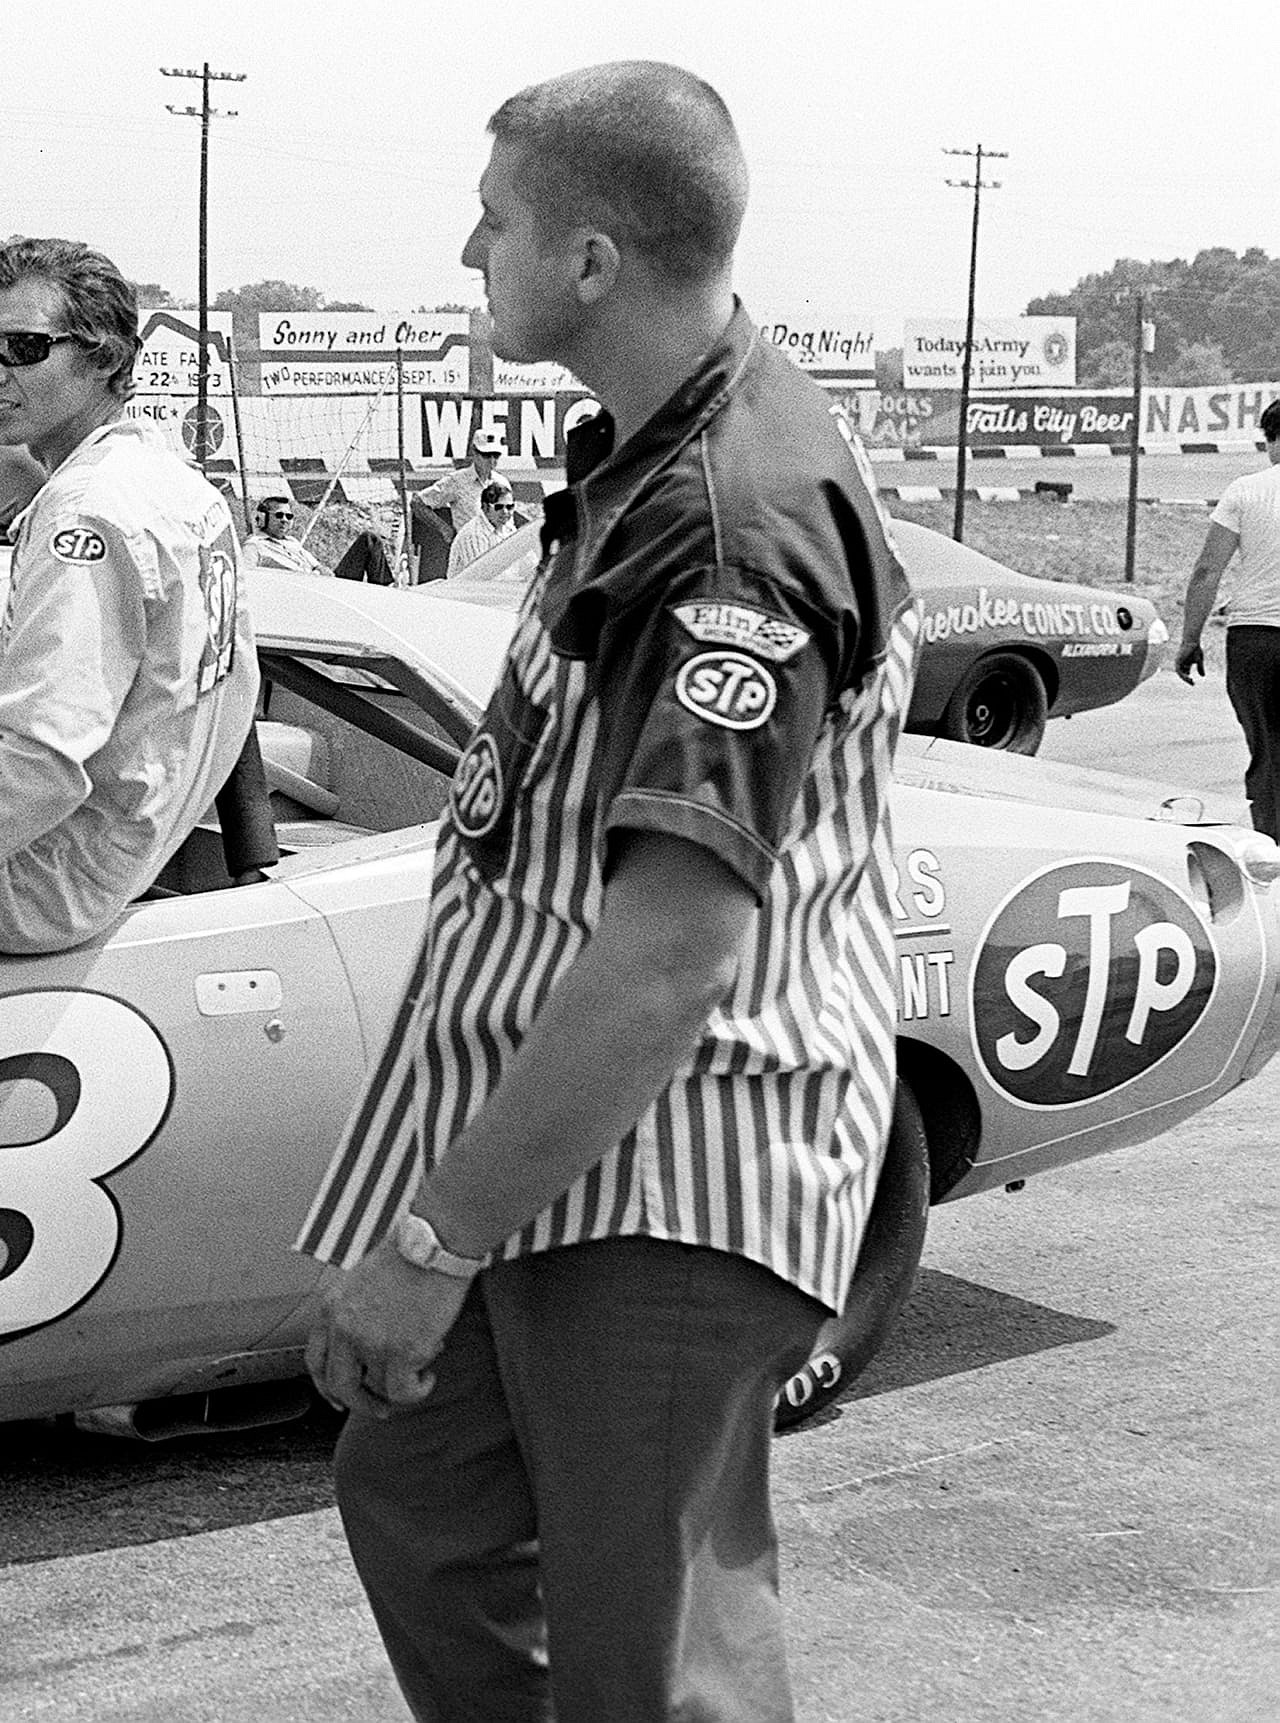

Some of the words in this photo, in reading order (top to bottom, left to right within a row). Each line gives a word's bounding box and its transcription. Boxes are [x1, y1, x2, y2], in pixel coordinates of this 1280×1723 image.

[273, 320, 337, 349] Sonny
[346, 325, 386, 344] and
[395, 321, 442, 344] Cher
[818, 330, 874, 361] Night
[917, 338, 979, 357] Todays
[979, 338, 1030, 358] Army
[188, 373, 221, 387] 193
[263, 365, 290, 390] TWO
[293, 370, 396, 386] PERFORMANCES
[402, 370, 437, 384] SEPT.
[497, 372, 547, 387] Mothers
[907, 364, 956, 376] wants
[979, 359, 1007, 383] join
[1011, 365, 1041, 382] you
[966, 402, 1028, 433] Falls
[1033, 405, 1077, 443] City
[1080, 406, 1134, 432] Beer
[1146, 391, 1263, 433] NASH
[55, 529, 106, 561] STP
[688, 661, 767, 713] STP
[890, 950, 955, 1021] NT
[996, 880, 1197, 1077] STP
